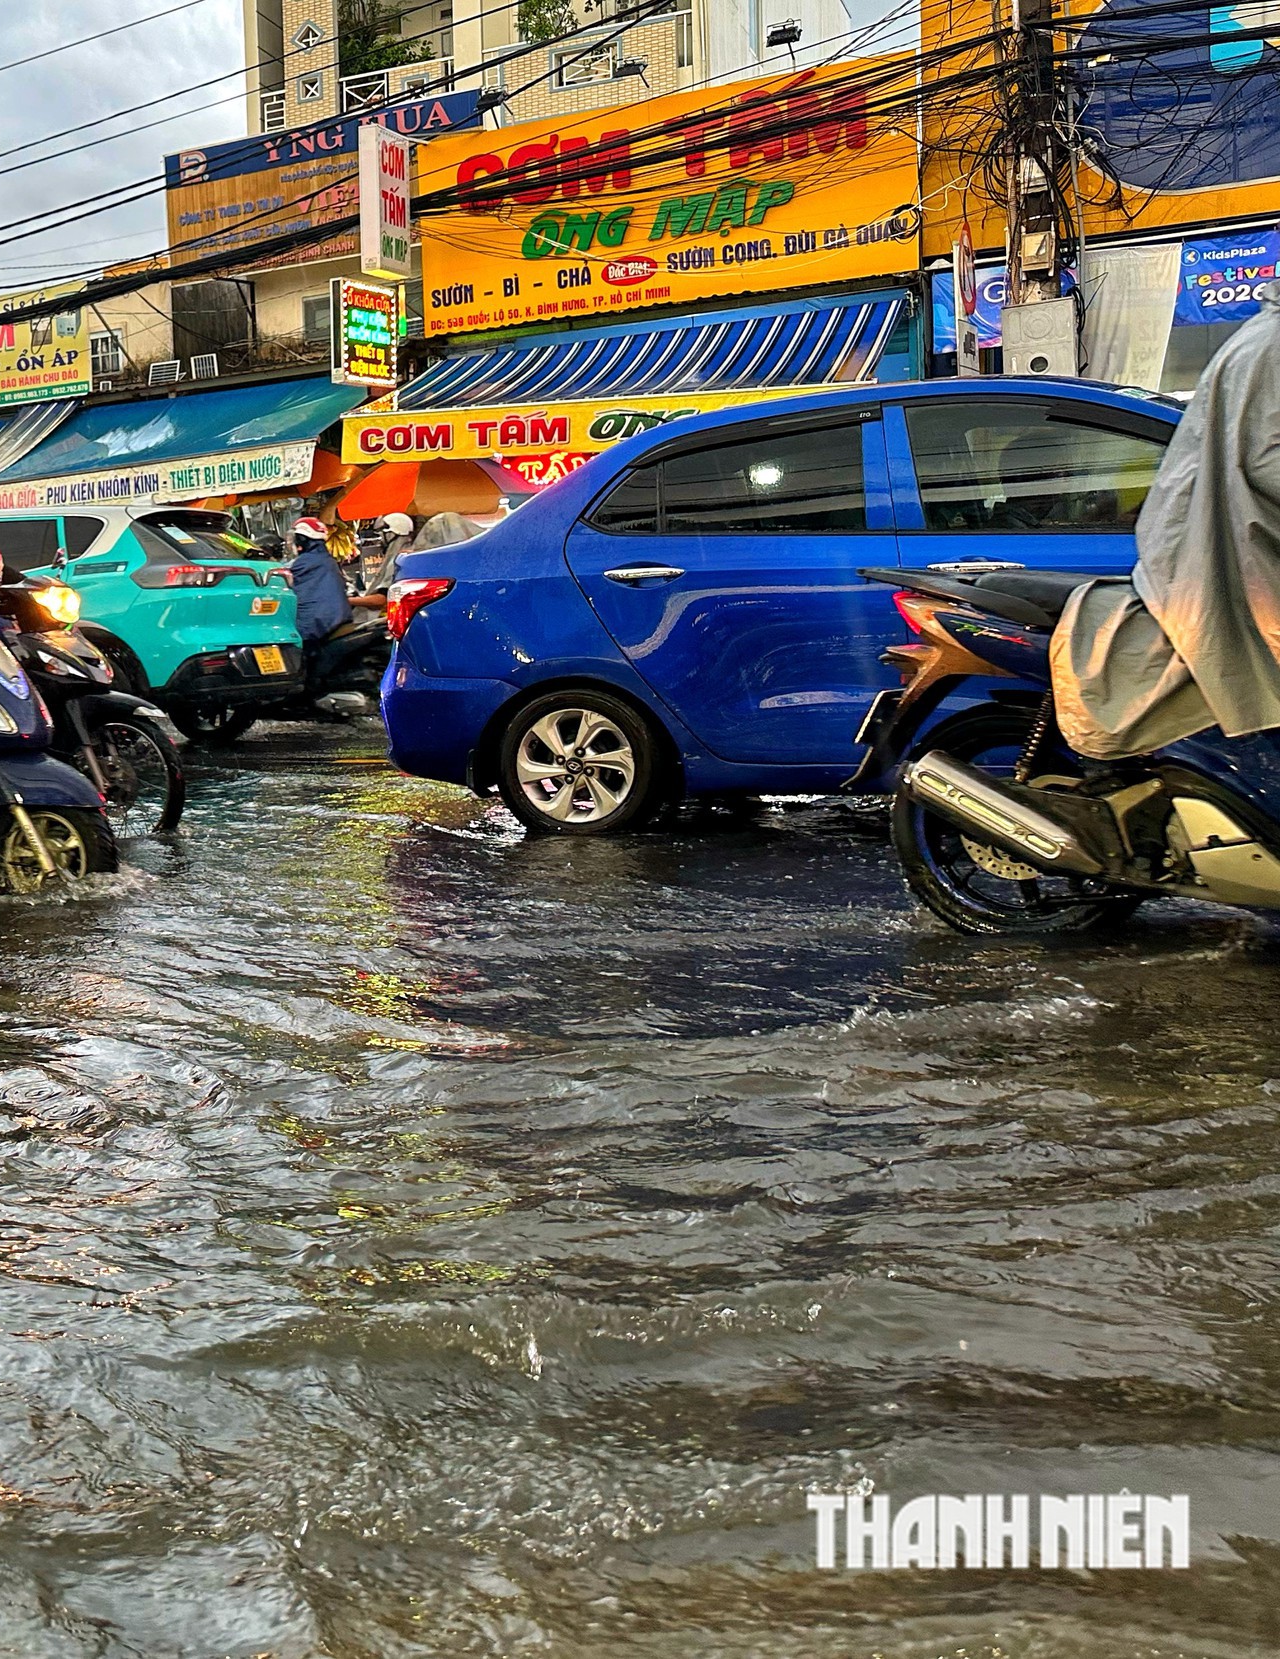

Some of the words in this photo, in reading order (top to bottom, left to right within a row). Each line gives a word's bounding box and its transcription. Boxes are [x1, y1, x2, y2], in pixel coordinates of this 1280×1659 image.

[457, 129, 631, 209] CƠM
[665, 70, 868, 176] TẤM
[380, 140, 405, 181] CƠM
[381, 186, 406, 228] TẤM
[521, 205, 635, 260] ÔNG
[648, 177, 796, 240] MẬP
[381, 231, 394, 258] ÔNG
[394, 235, 409, 264] MẬP
[431, 282, 474, 309] SƯỜN
[503, 273, 520, 298] BÌ
[557, 259, 592, 290] CHẢ
[667, 242, 715, 272] SƯỜN
[823, 223, 849, 249] GÀ
[1203, 246, 1267, 261] KidsPlaza
[354, 292, 374, 310] KHÓA
[375, 295, 391, 313] CỬA
[467, 308, 490, 327] QUỐC
[493, 308, 505, 323] LỘ
[537, 300, 559, 316] BÌNH
[592, 297, 607, 308] TP.
[610, 290, 623, 305] HỒ
[626, 288, 642, 303] CHÍ
[645, 286, 671, 301] MINH
[1201, 282, 1267, 307] 2026
[16, 349, 44, 372] ỔN
[52, 348, 78, 367] ÁP
[354, 343, 375, 359] THIẾT
[376, 348, 386, 366] BỊ
[19, 374, 41, 387] HÀNH
[43, 371, 60, 384] CHU
[359, 424, 453, 454] CƠM
[468, 411, 570, 447] TẤM
[16, 485, 37, 508] CỬA
[70, 479, 95, 505] KIỆN
[98, 475, 131, 500] NHÔM
[133, 473, 159, 495] KÍNH
[169, 463, 201, 490] THIẾT
[204, 466, 216, 489] BỊ
[219, 459, 246, 487] ĐIỆN
[250, 454, 281, 480] NƯỚC
